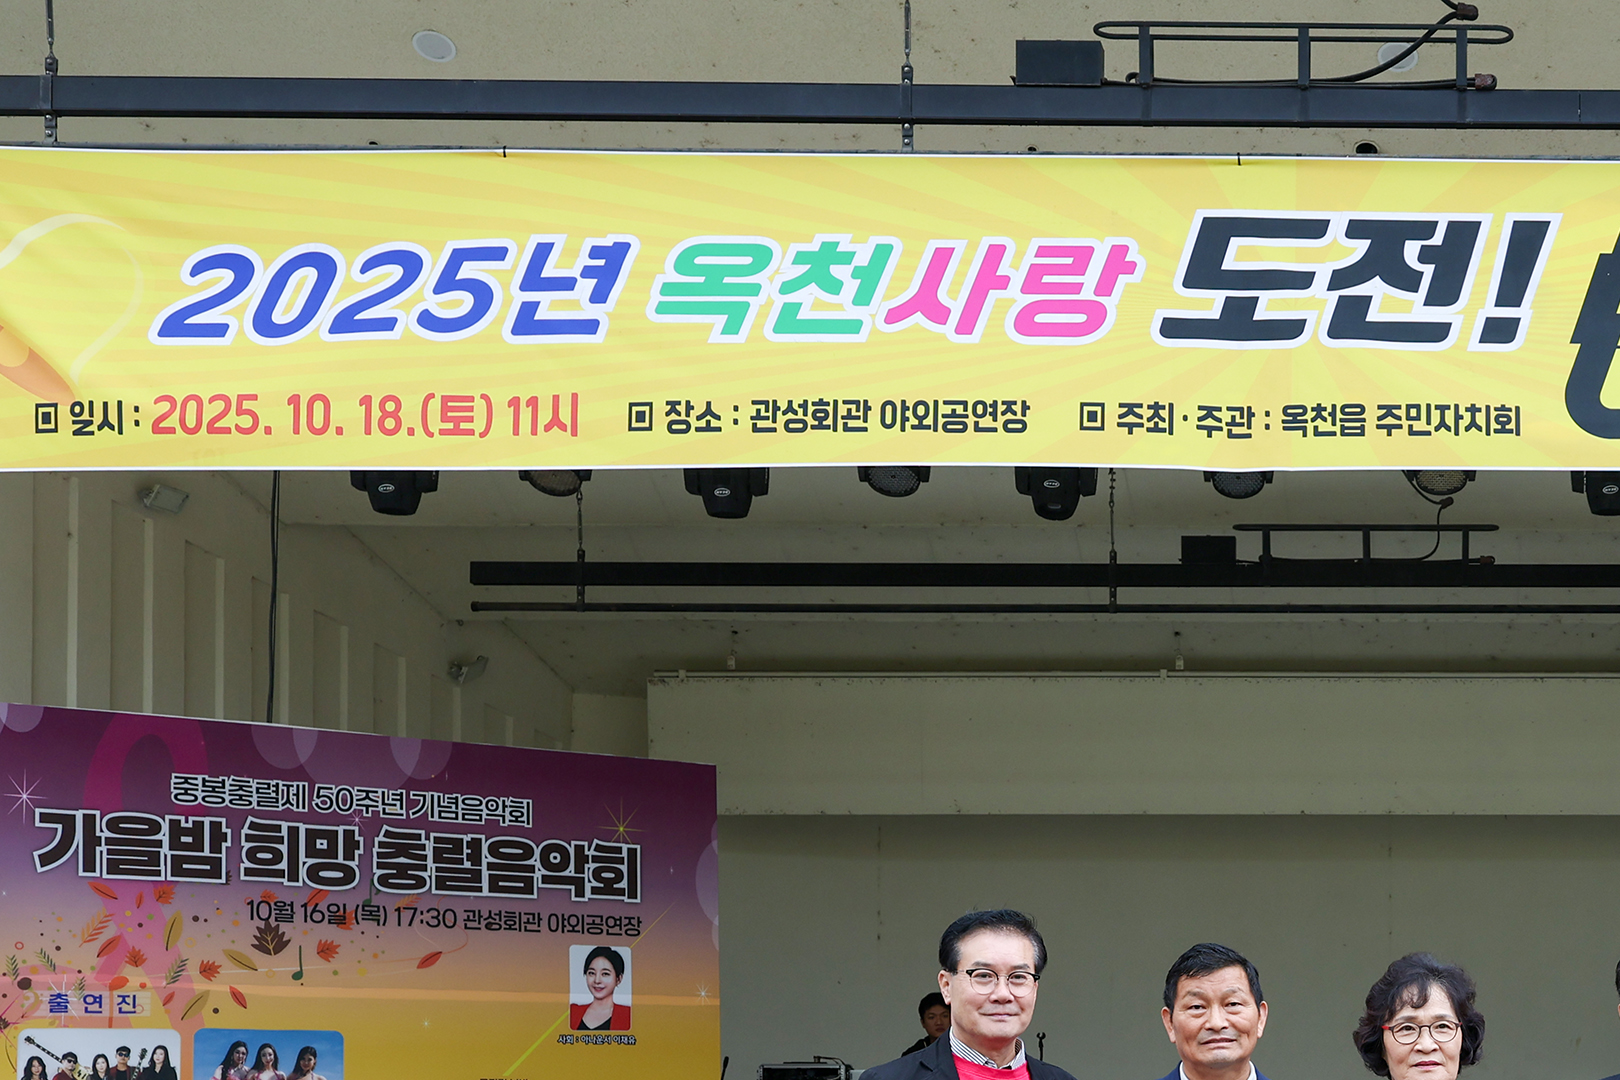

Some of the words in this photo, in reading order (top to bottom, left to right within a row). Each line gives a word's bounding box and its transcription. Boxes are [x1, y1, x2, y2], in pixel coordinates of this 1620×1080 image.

[155, 238, 634, 342] 2025년
[651, 238, 1140, 340] 옥천사랑
[1155, 212, 1557, 348] 도전!
[69, 400, 125, 436] 일시
[151, 394, 272, 437] 2025.
[287, 394, 343, 437] 10.
[360, 394, 493, 440] 18.(토)
[507, 393, 580, 438] 11시
[664, 400, 724, 434] 장소
[749, 400, 873, 434] 관성회관
[879, 401, 1031, 434] 야외공연장
[1116, 402, 1175, 437] 주최
[1196, 405, 1254, 439] 주관
[1280, 405, 1367, 437] 옥천읍
[1375, 404, 1522, 437] 주민자치회
[171, 774, 308, 812] 중봉충렬제
[313, 784, 406, 818] 50주년
[409, 792, 532, 827] 기념음악회
[34, 809, 231, 883] 가을밤
[240, 816, 363, 889] 희망
[373, 825, 641, 902] 충렬음악회
[247, 899, 296, 924] 10월
[300, 901, 347, 926] 16일
[353, 904, 388, 928] (목)
[393, 906, 458, 930] 17:30
[462, 908, 542, 934] 관성회관
[547, 913, 643, 937] 야외공연장
